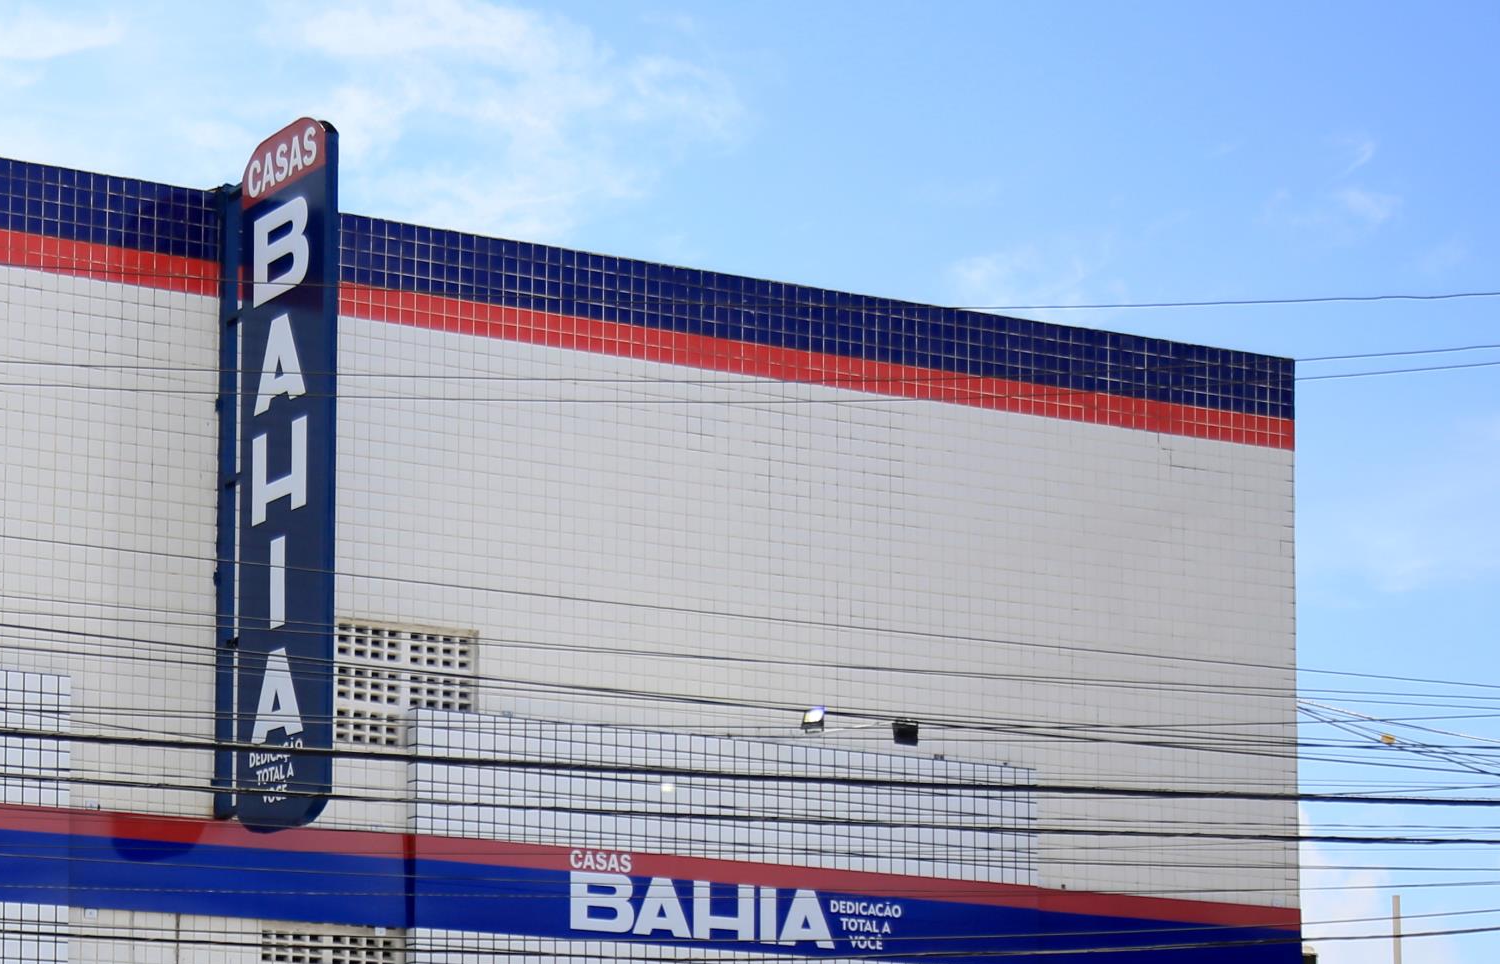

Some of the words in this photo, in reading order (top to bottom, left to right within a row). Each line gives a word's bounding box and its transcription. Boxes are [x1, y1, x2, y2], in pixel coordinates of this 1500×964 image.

[248, 126, 317, 198] CASAS
[251, 196, 310, 745] BAHIA
[256, 763, 285, 786] TOTAL
[286, 762, 295, 778] A
[569, 850, 632, 873] CASAS
[569, 870, 836, 950] BAHIA
[840, 917, 879, 933] TOTAL
[881, 920, 891, 934] A
[849, 933, 883, 950] VOCÊ
